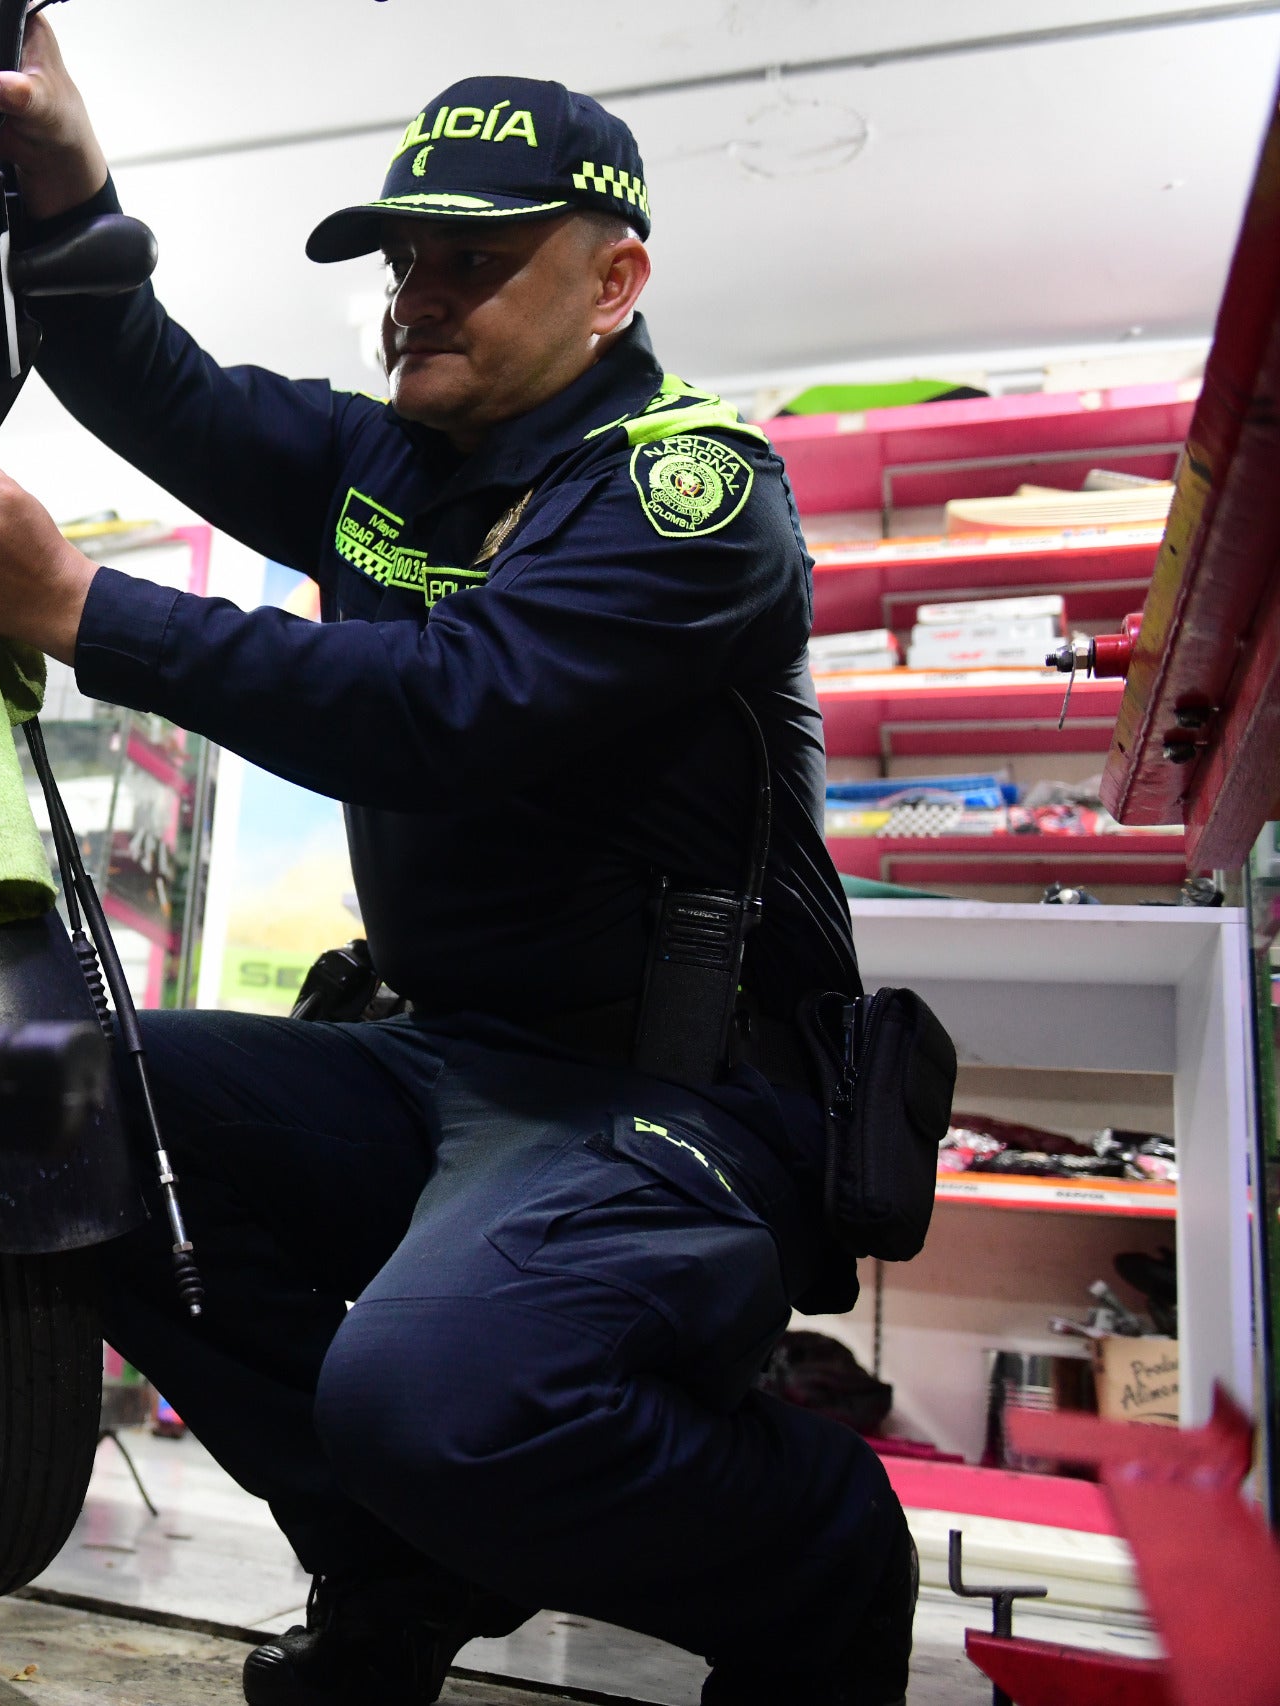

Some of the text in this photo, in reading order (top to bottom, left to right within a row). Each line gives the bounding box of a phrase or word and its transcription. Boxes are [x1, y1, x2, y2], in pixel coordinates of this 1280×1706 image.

[386, 100, 538, 175] OLICÍA
[643, 444, 740, 495] NACIONAL
[341, 517, 375, 546] CESAR
[648, 501, 695, 531] COLOMBIA
